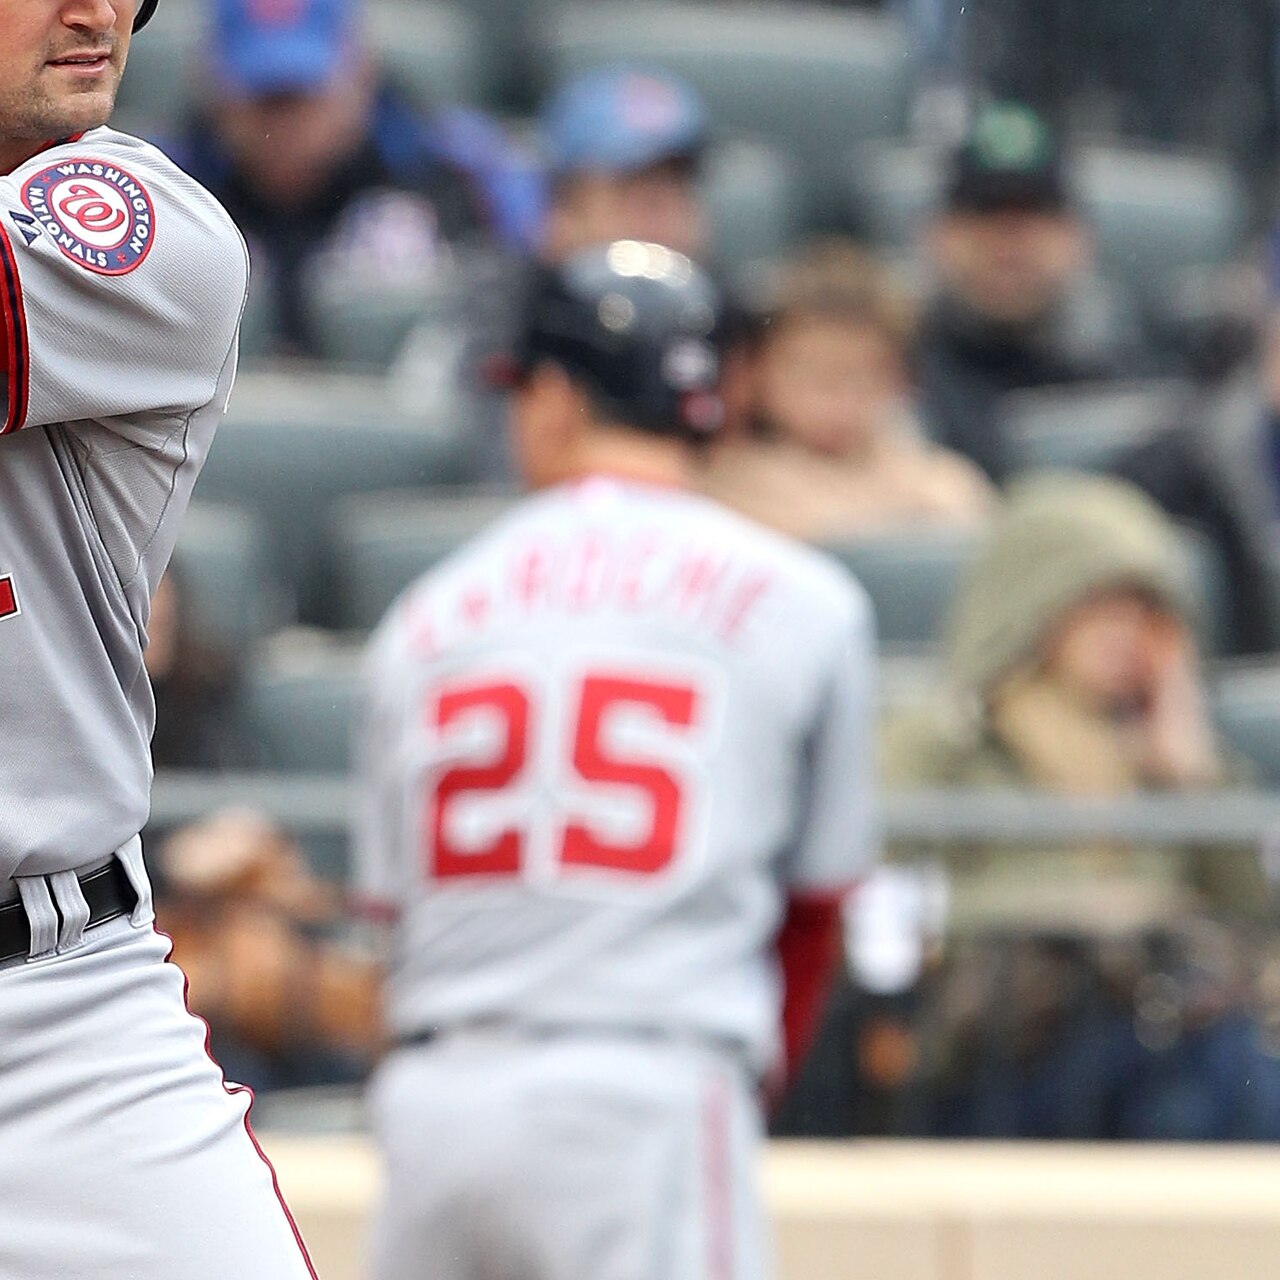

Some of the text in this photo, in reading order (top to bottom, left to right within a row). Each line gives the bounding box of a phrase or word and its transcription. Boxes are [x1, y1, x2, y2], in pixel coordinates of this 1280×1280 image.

[28, 187, 109, 268] NATIONALS
[56, 163, 151, 255] WASHINGTON
[428, 672, 700, 883] 25
